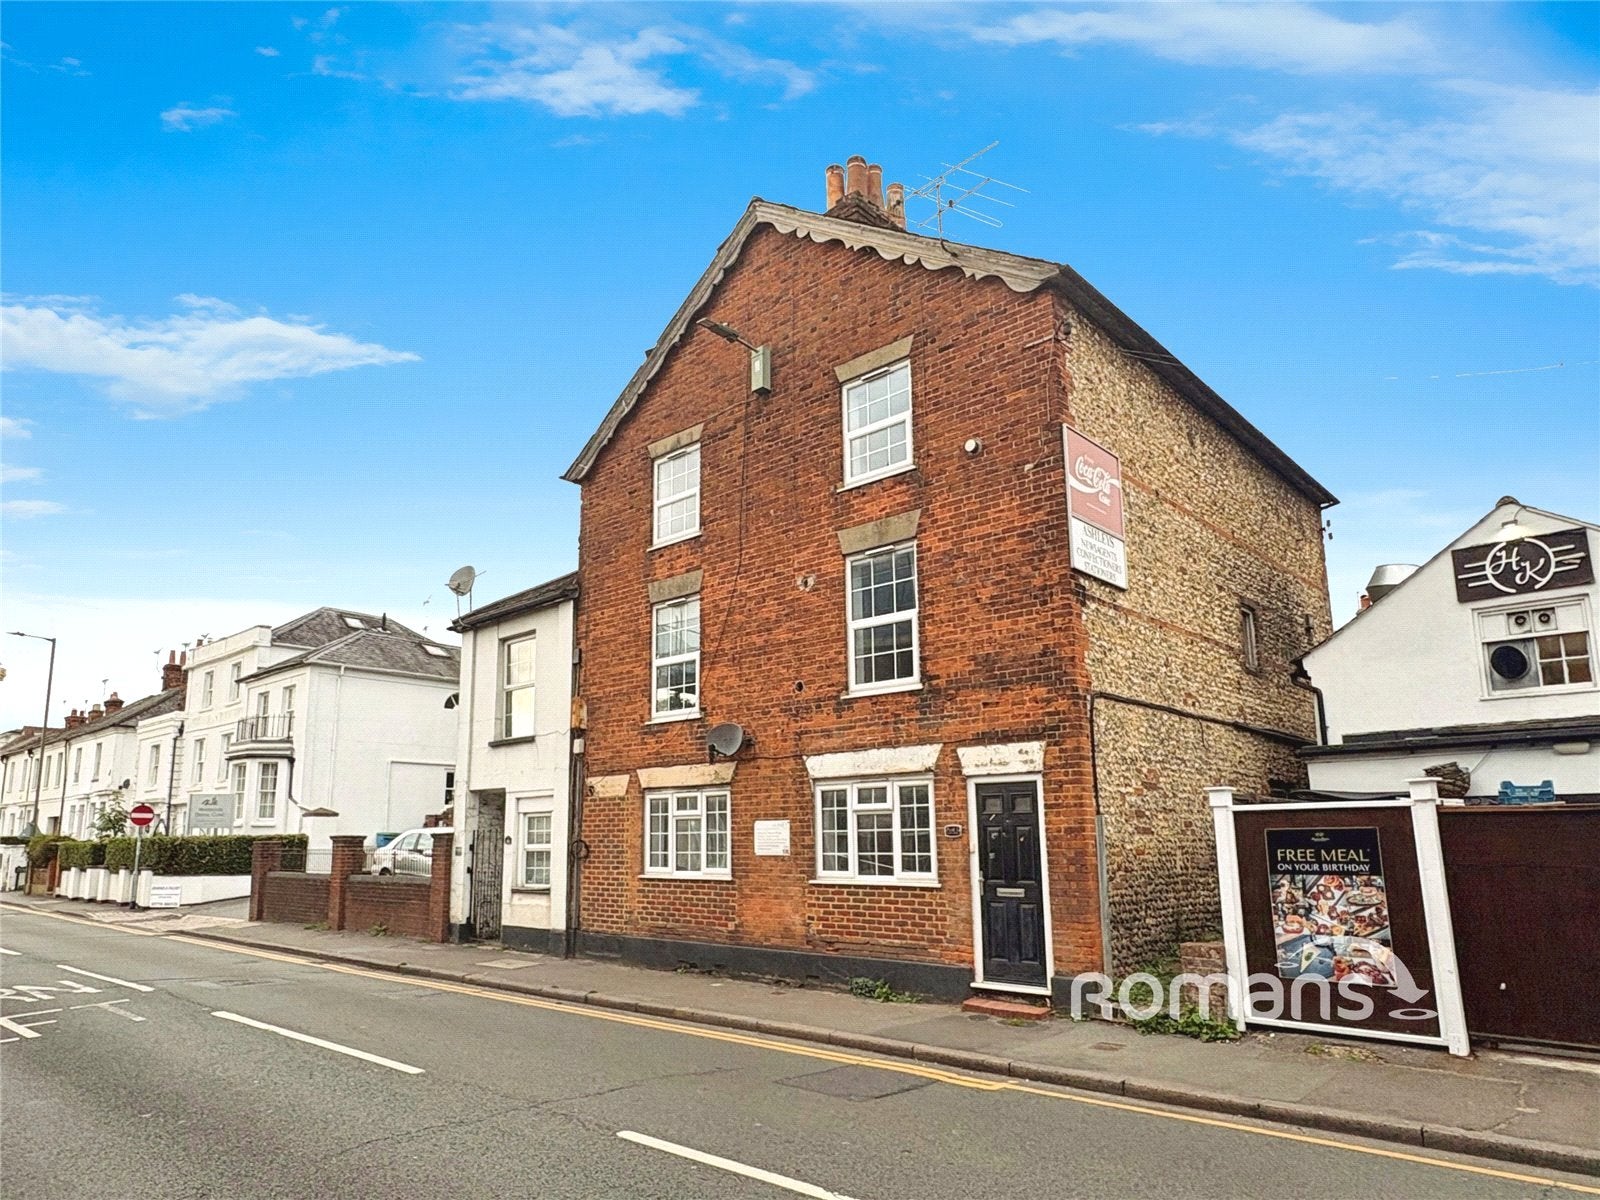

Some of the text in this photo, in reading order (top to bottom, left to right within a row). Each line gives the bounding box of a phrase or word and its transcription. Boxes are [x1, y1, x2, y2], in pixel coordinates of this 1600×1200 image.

[1277, 849, 1316, 862] FREE
[1277, 863, 1371, 872] ON YOUR BIRTHDAY
